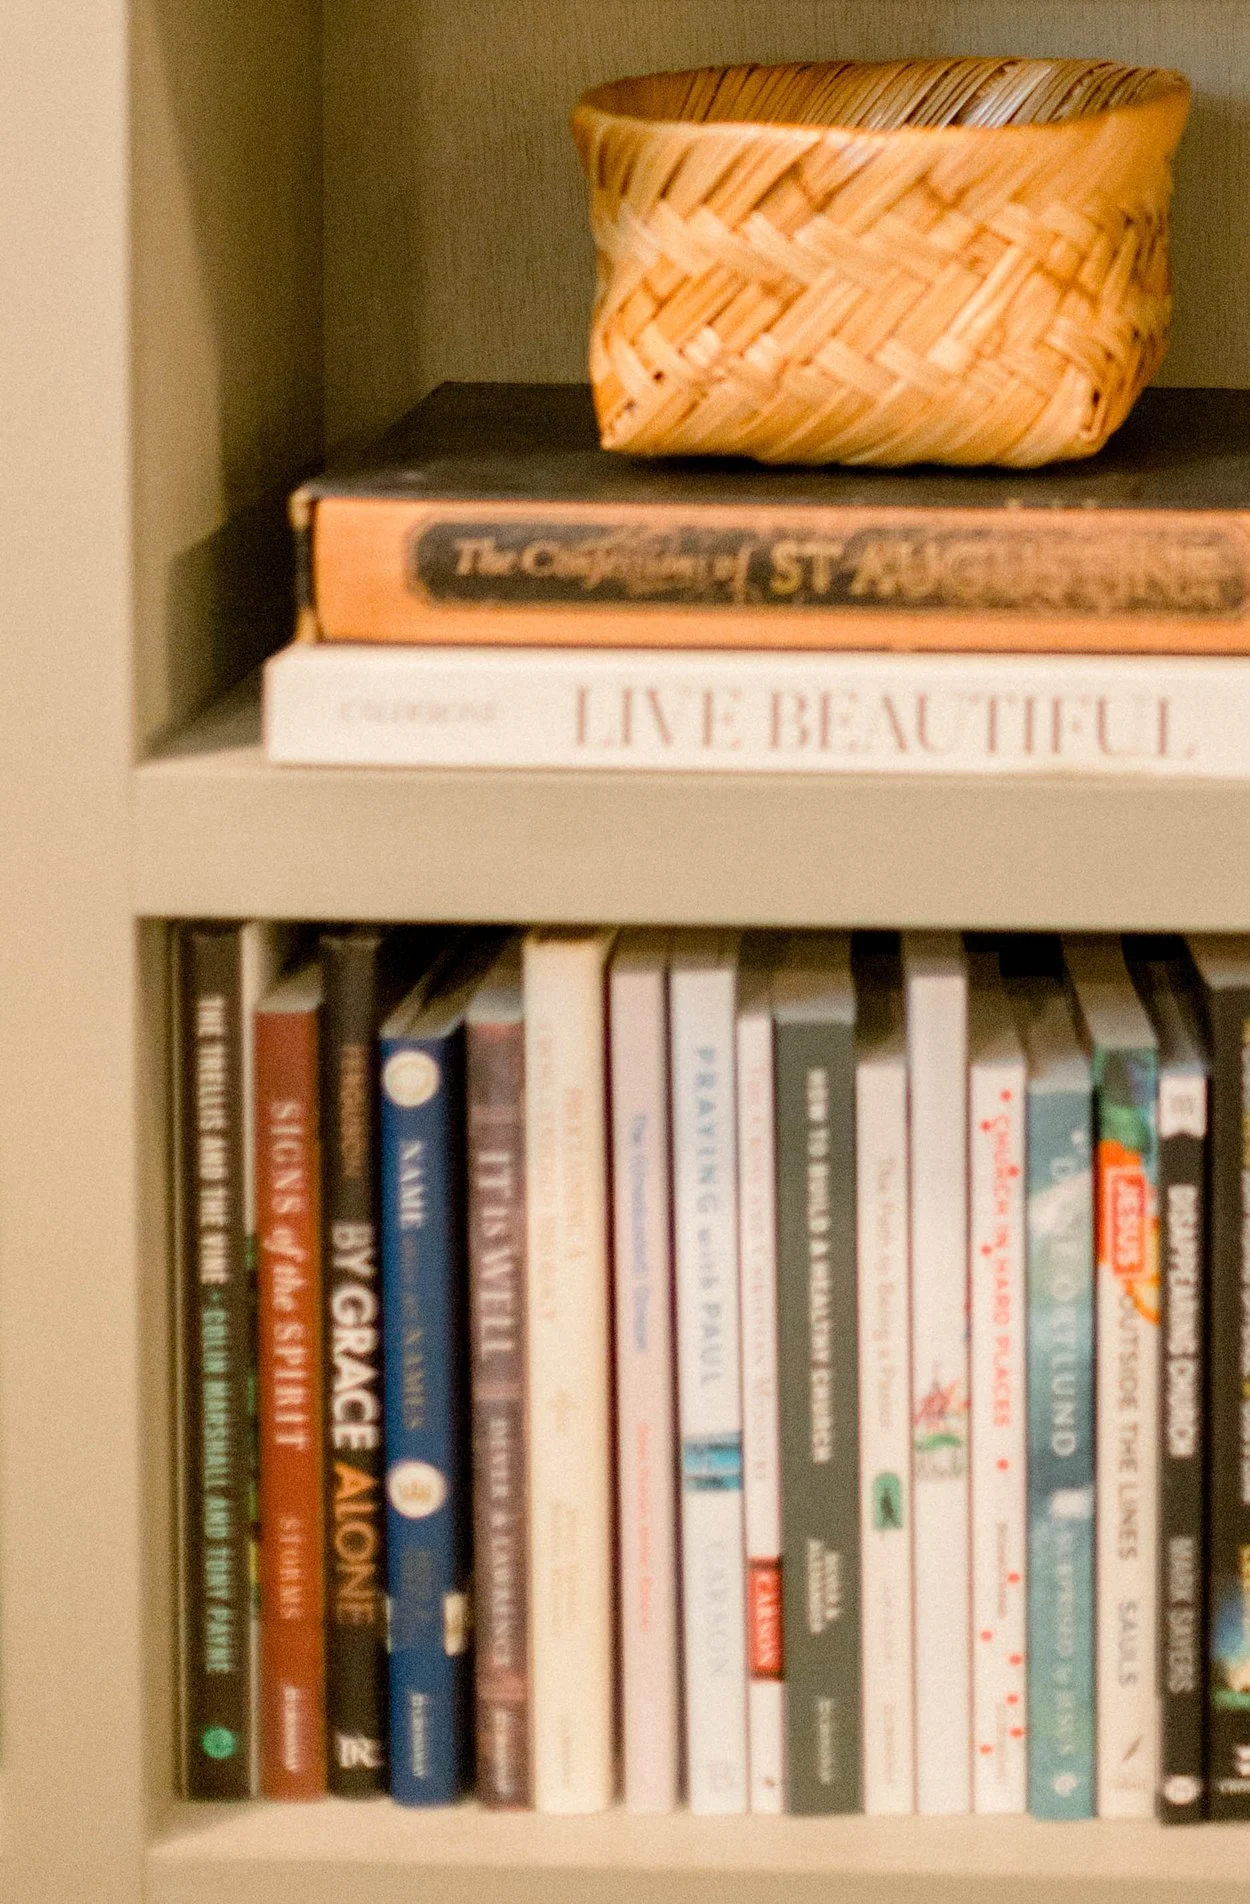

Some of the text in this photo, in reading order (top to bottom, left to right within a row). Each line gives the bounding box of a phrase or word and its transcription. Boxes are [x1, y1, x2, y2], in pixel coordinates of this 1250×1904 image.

[454, 536, 520, 577] The
[770, 540, 842, 594] ST
[574, 688, 1199, 757] LIVE BEAUTIFUL
[476, 1149, 515, 1199] IT
[695, 1044, 718, 1214] PRAYING
[196, 994, 235, 1674] THE TRELLIS AND THE VINE COLIN MARSHALL AND TONY PAYNE
[261, 1099, 311, 1451] SIGNS of the SPIRIT
[398, 1136, 431, 1431] NAME NAMES
[479, 1245, 517, 1361] WELL
[806, 1067, 834, 1463] HOW TO BUILD A HEALTHY CHURCH
[993, 1115, 1011, 1428] CHURCH IN HARD PLACES
[1168, 1183, 1198, 1457] DISAPPEARING CHURCH
[331, 1219, 381, 1628] BY GRACE ALONE
[699, 1301, 723, 1388] PAUL
[1117, 1181, 1140, 1561] JESUS OUTSIDE THE LINES
[279, 1514, 305, 1620] STORMS
[703, 1541, 727, 1679] CARSON
[755, 1572, 776, 1668] CARSON
[1118, 1600, 1139, 1688] SAULS
[1169, 1536, 1196, 1694] MARK SAYERS
